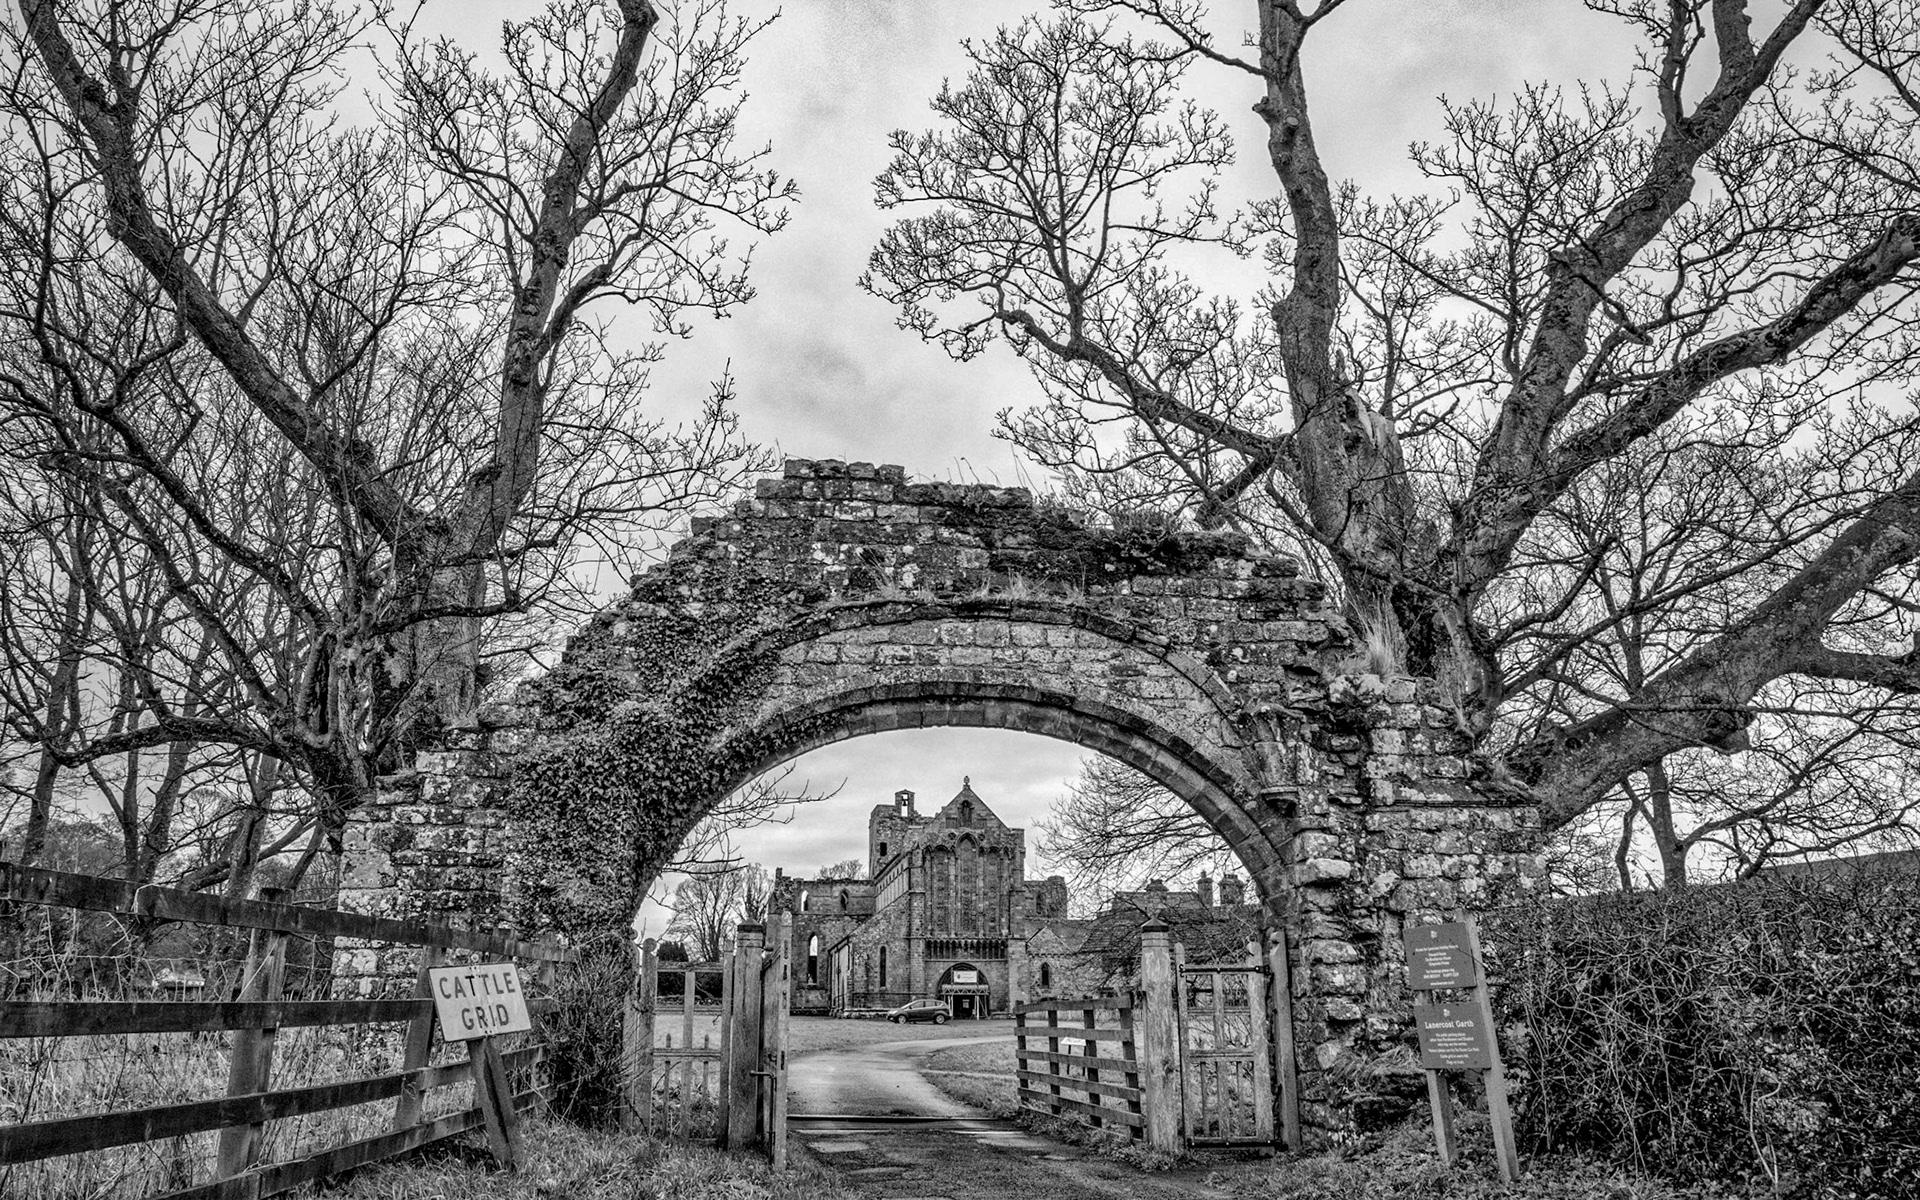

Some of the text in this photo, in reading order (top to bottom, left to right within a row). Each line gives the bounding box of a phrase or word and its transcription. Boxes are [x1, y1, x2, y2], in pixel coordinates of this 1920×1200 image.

[439, 972, 515, 999] CATTLE
[461, 1003, 509, 1030] GRID
[1424, 1019, 1474, 1029] Lanercost Garth
